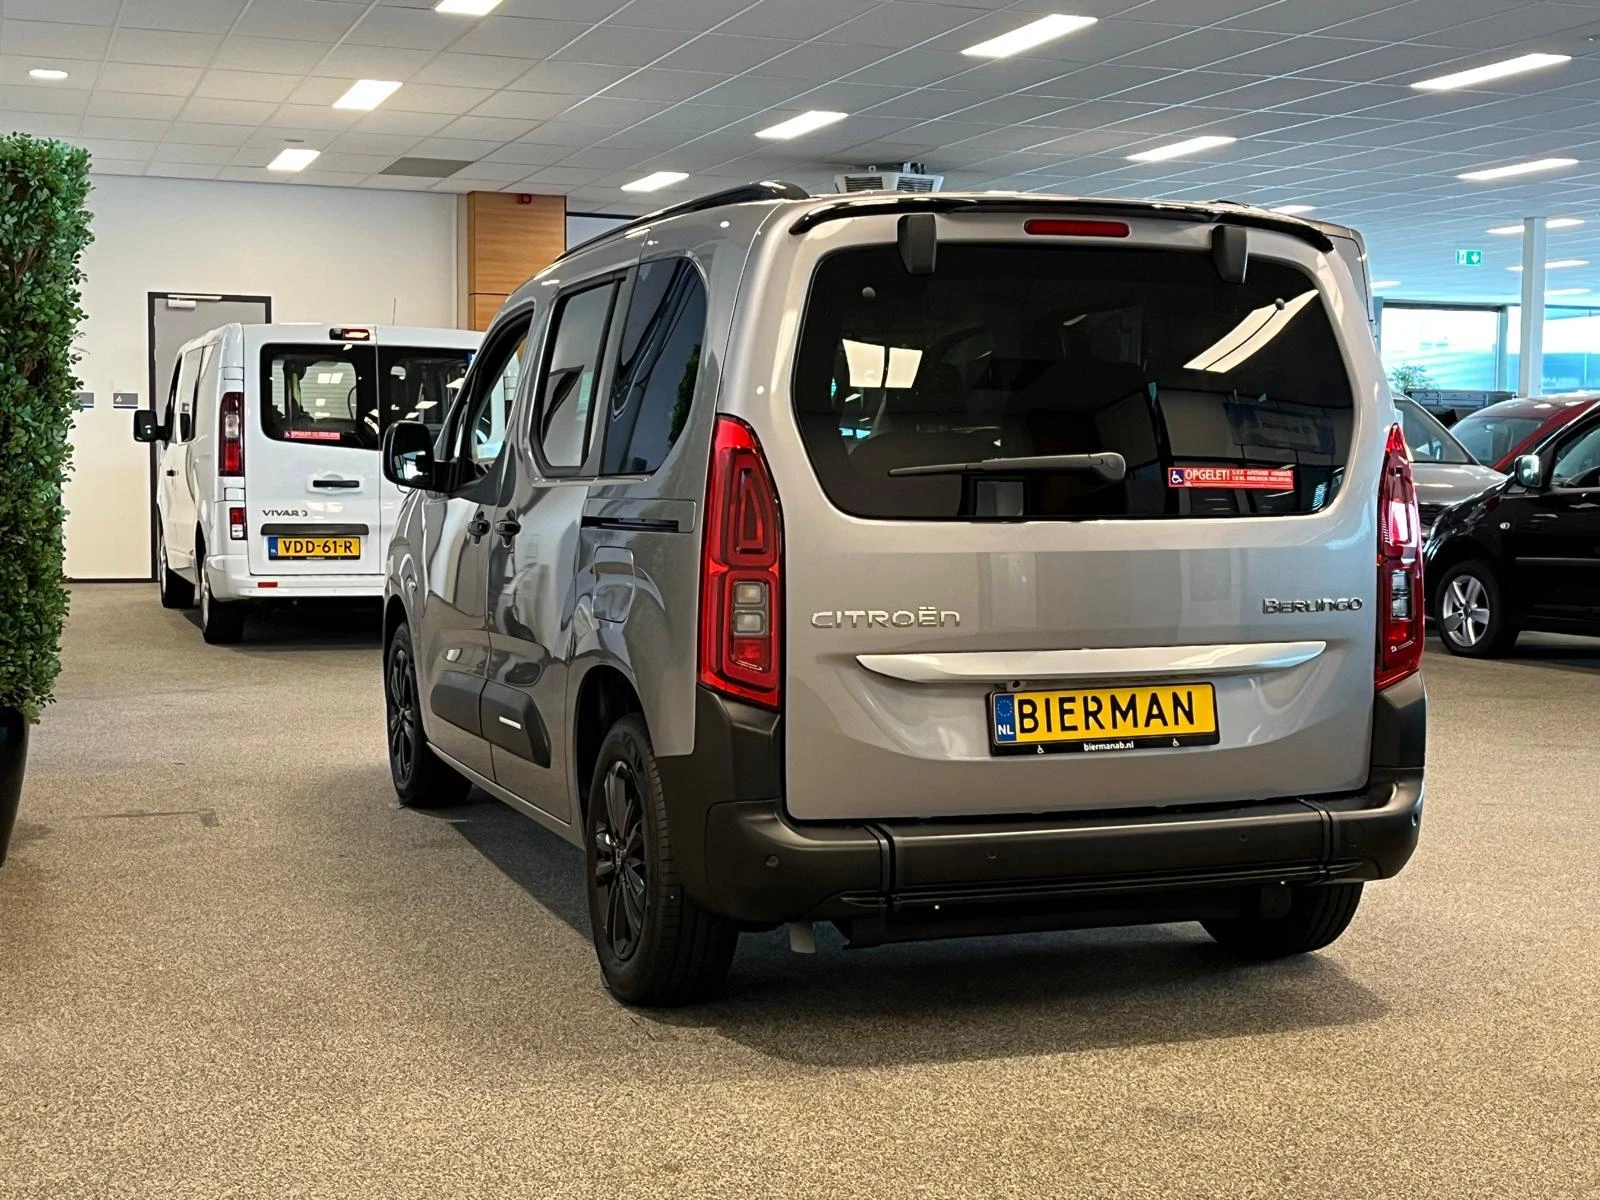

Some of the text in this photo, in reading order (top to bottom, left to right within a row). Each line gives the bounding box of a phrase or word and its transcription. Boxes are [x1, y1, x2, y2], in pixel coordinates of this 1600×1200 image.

[1185, 469, 1230, 480] OPGELET!
[283, 540, 353, 553] VDD-61-R
[1017, 691, 1195, 734] BIERMAN
[998, 724, 1015, 735] NL
[1083, 741, 1135, 751] biermanab.nl
